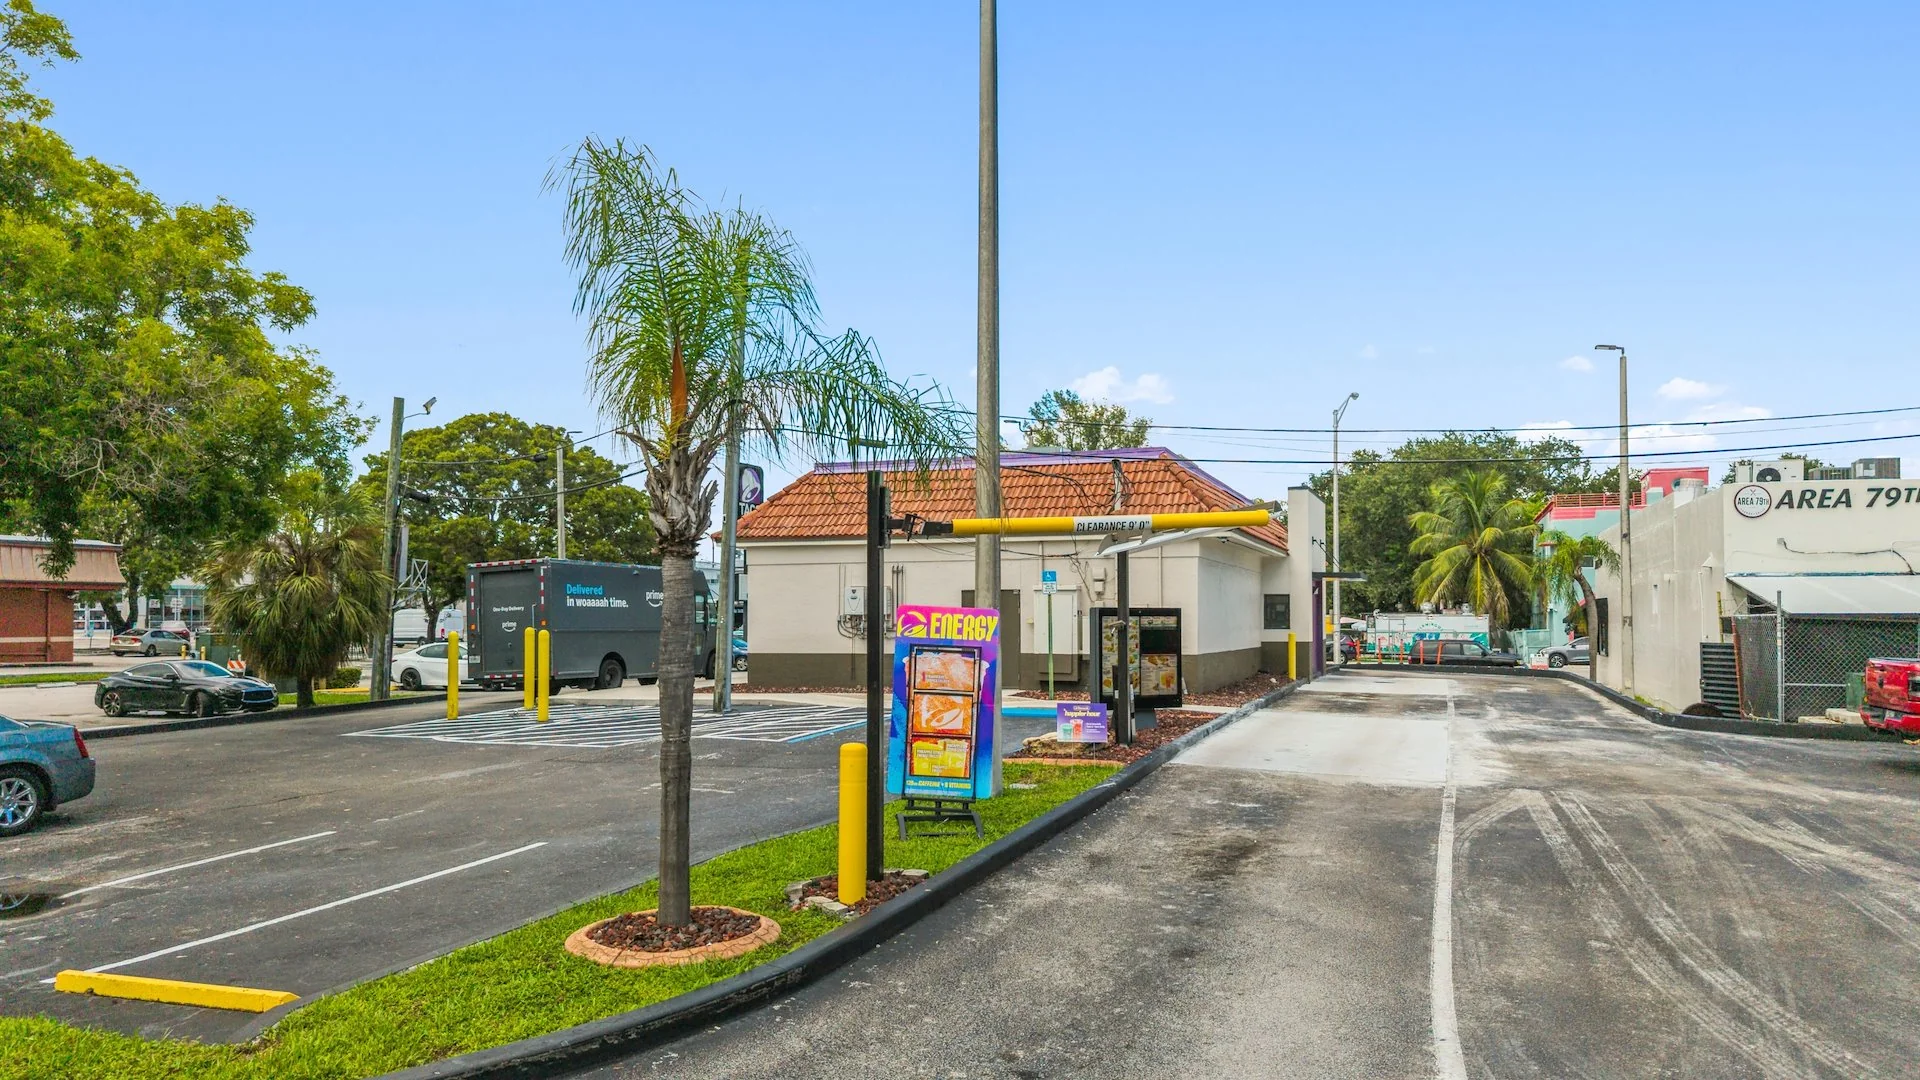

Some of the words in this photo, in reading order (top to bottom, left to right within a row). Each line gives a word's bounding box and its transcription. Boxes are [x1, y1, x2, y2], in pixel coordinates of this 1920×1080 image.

[1737, 497, 1754, 506] AREA
[1774, 488, 1852, 510] AREA
[739, 502, 759, 516] TAC
[1076, 521, 1127, 532] CLEARANCE
[566, 583, 603, 595] Delivered
[645, 589, 664, 602] prime
[566, 595, 575, 607] in
[575, 597, 609, 608] woaaaah
[609, 597, 629, 608] time.
[501, 620, 517, 629] prime
[929, 612, 999, 642] ENERGY
